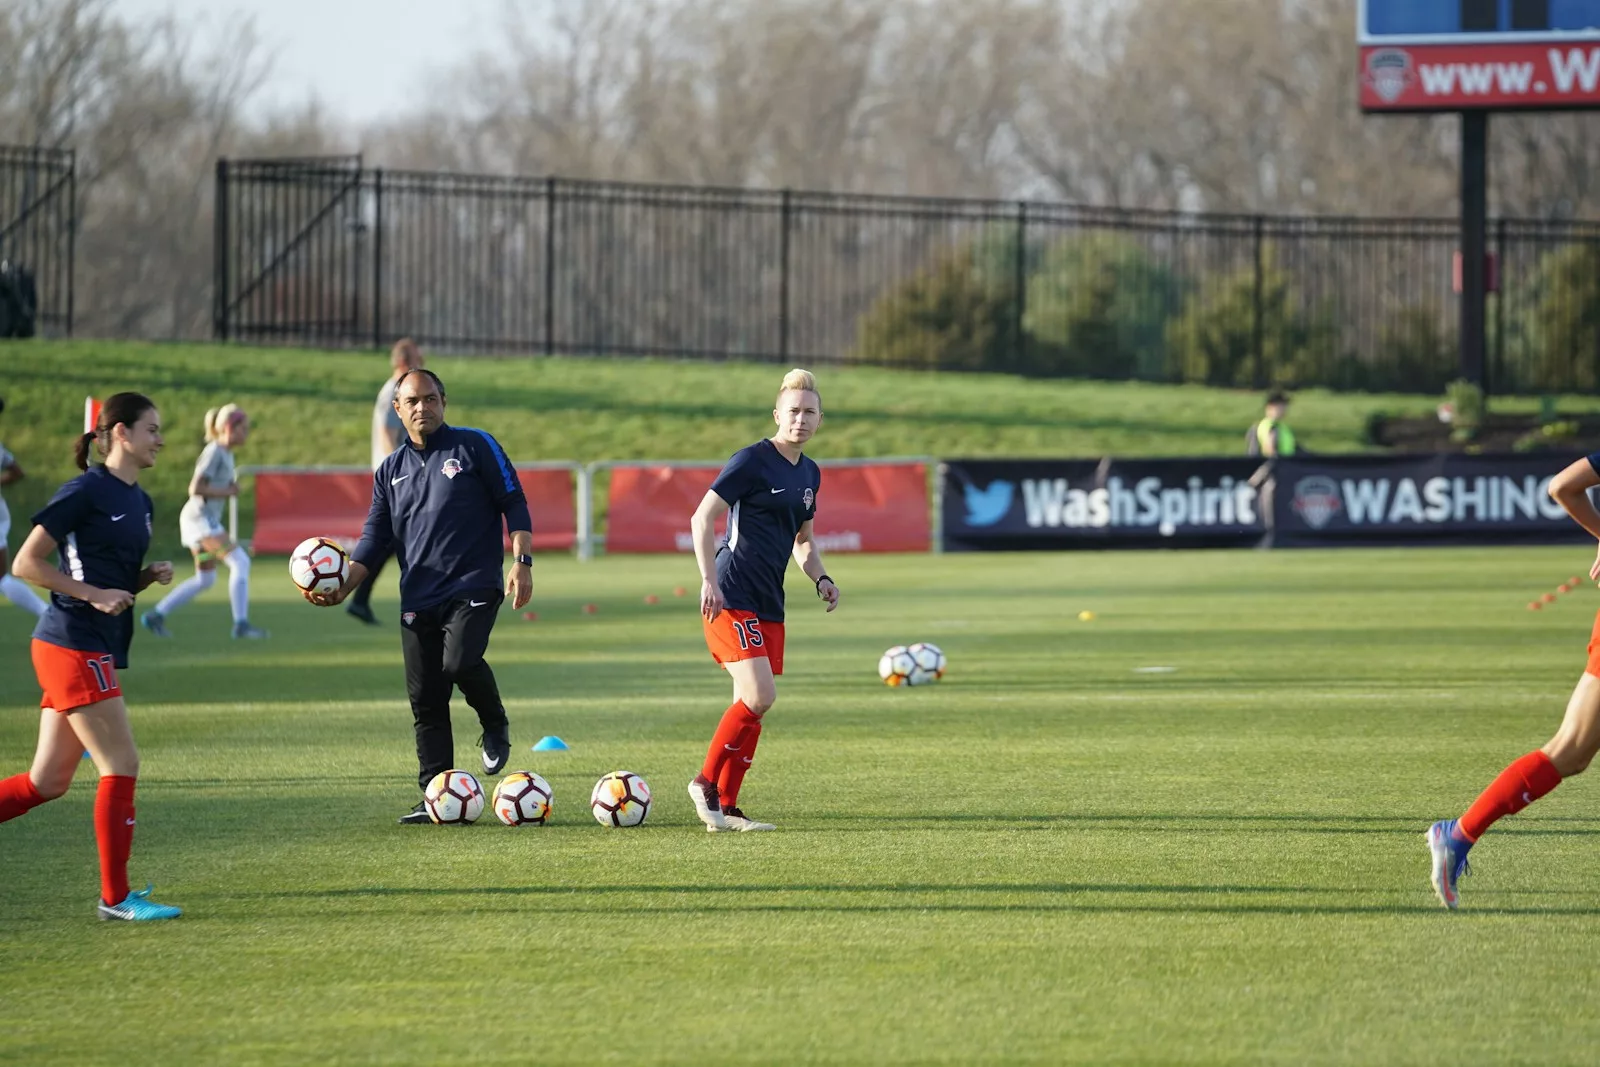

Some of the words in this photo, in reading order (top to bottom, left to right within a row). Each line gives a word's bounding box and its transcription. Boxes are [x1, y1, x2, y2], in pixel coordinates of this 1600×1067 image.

[1418, 48, 1600, 95] www.W
[1021, 476, 1257, 536] WashSpirit
[1341, 475, 1594, 523] WASHIN
[733, 618, 764, 650] 15
[86, 654, 118, 692] 17
